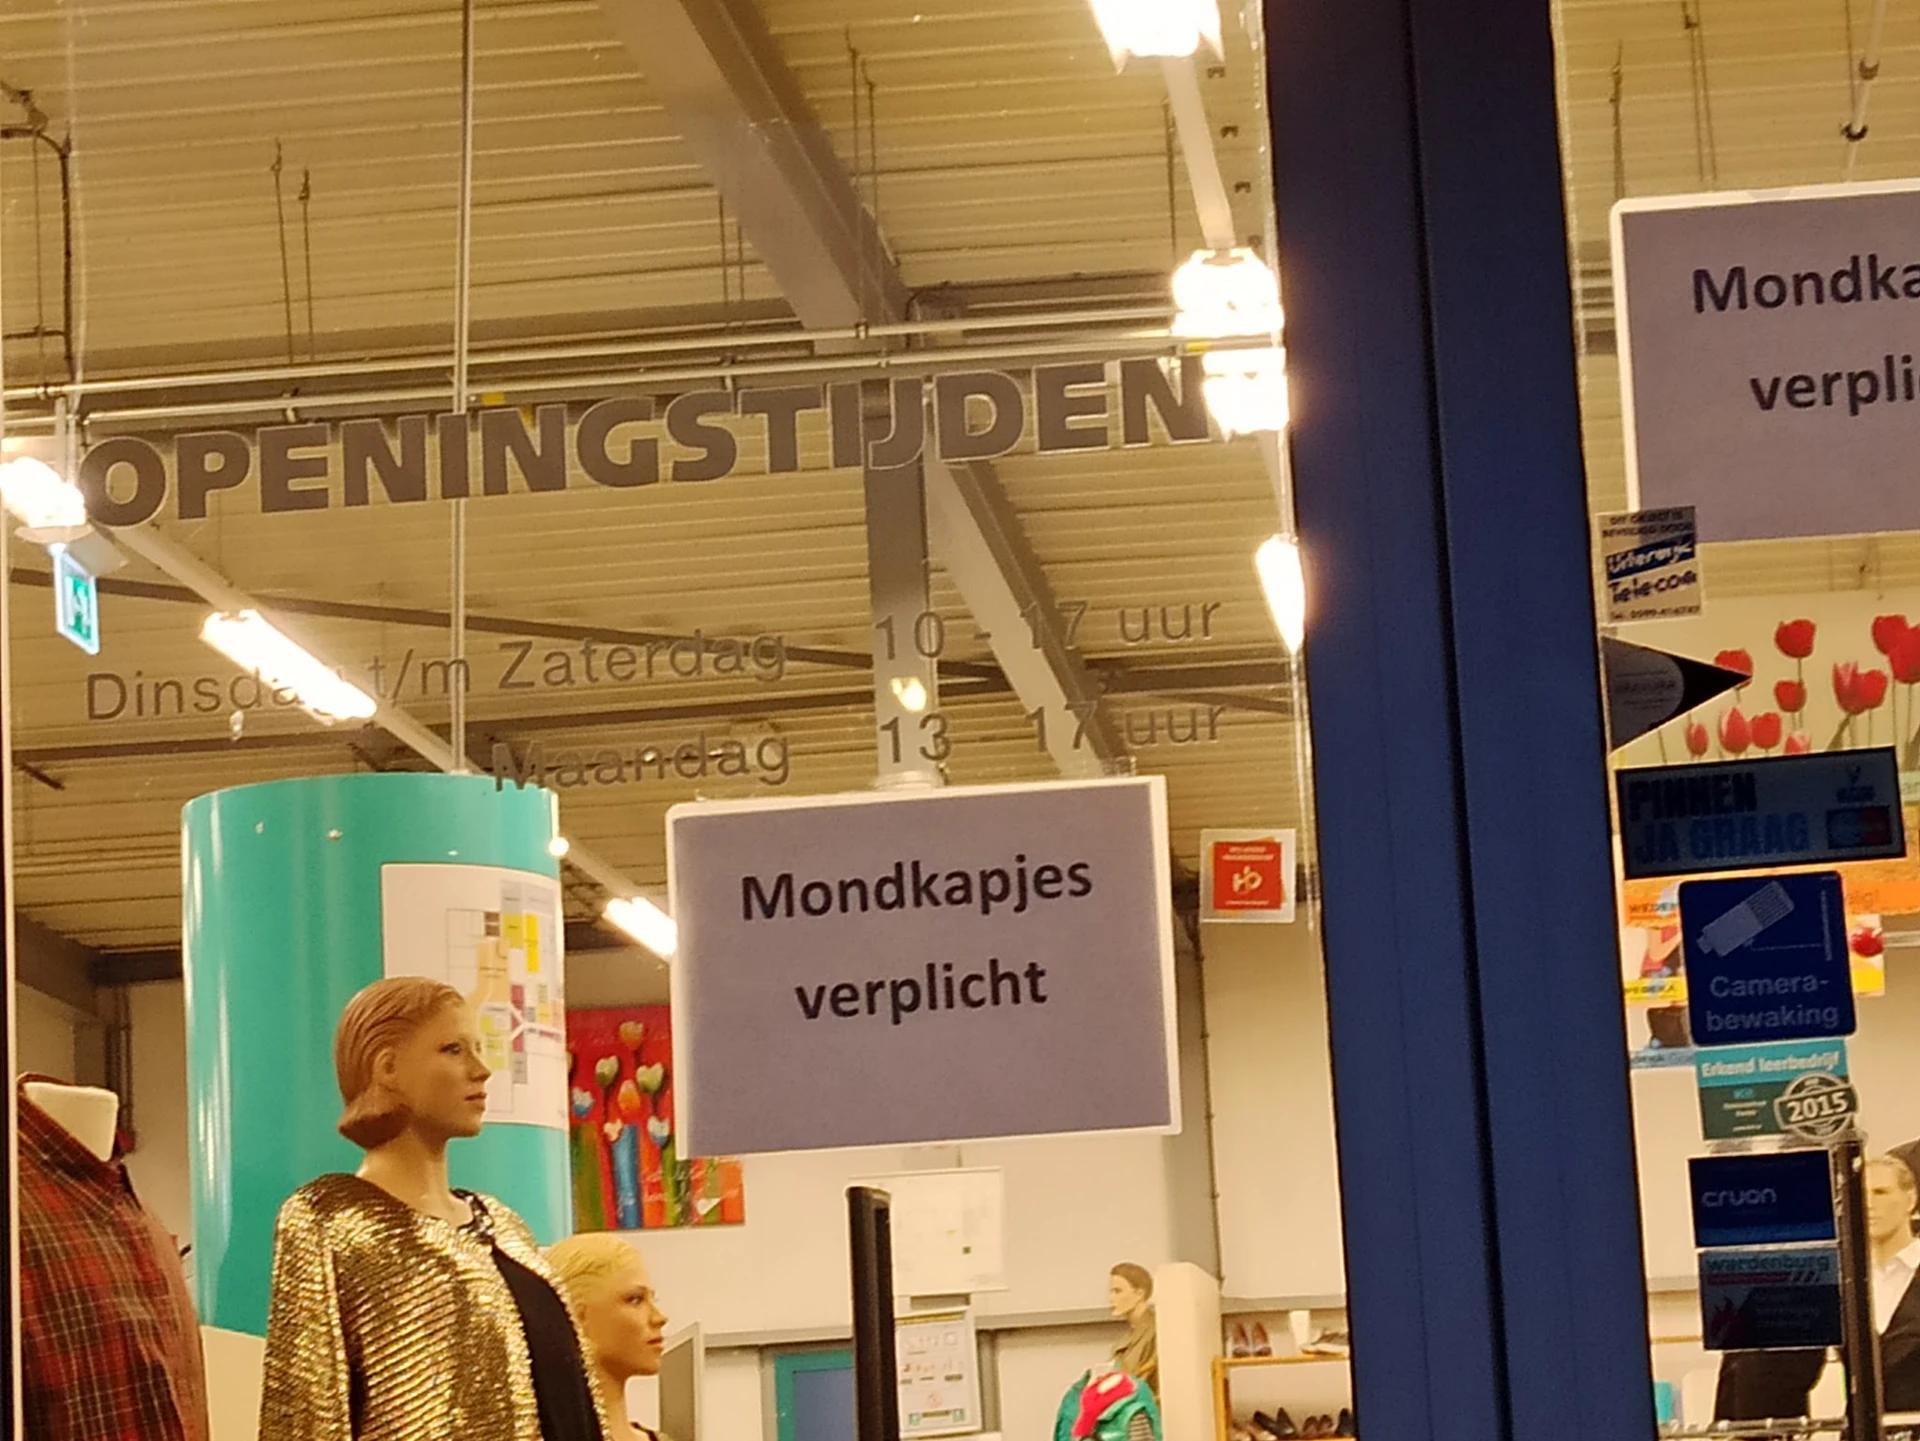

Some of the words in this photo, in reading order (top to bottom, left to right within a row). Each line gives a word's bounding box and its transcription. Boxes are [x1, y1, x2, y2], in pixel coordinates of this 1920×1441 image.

[1748, 354, 1920, 417] verpli
[80, 355, 1210, 528] OPENINGSTIJDEN
[87, 664, 340, 722] Dinsda
[369, 647, 472, 709] t/m
[498, 628, 788, 690] Zaterdag
[875, 610, 945, 661] 10
[1118, 600, 1221, 644] uur
[491, 732, 790, 793] Maandag
[879, 711, 951, 763] 13
[1026, 700, 1098, 751] 17
[1123, 702, 1226, 748] uur
[1628, 771, 1758, 822] PINNEN
[741, 854, 1093, 921] Mondkapjes
[795, 959, 1048, 1025] verplicht
[1705, 1004, 1840, 1032] bewaking
[1709, 974, 1829, 998] Camera-
[1786, 1091, 1849, 1122] 2015
